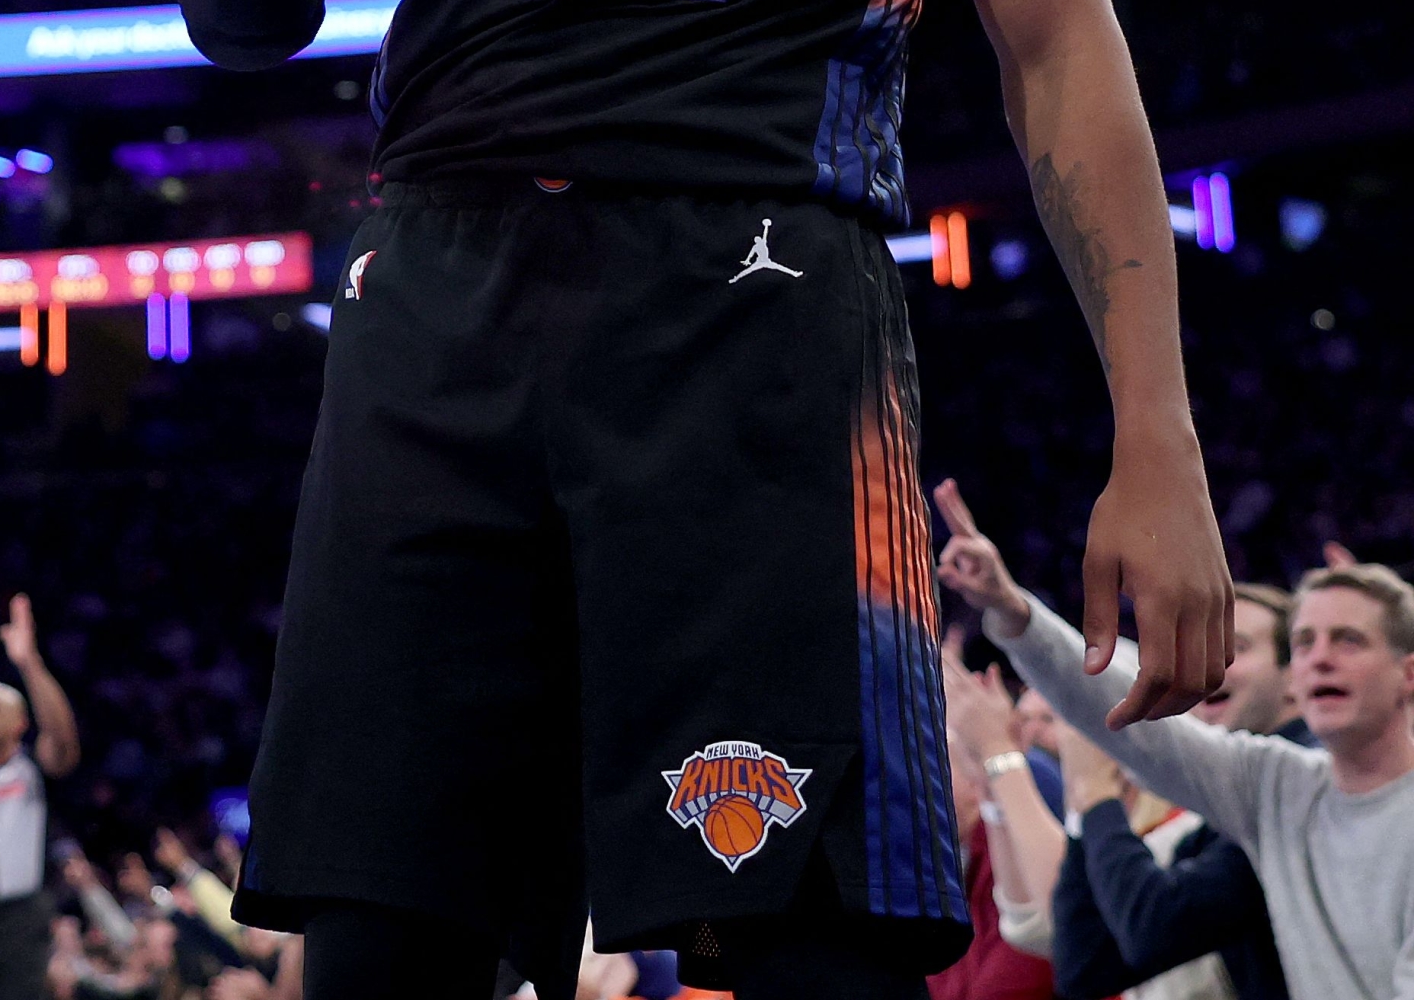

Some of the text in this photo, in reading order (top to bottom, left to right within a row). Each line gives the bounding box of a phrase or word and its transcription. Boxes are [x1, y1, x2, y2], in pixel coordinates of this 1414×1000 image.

[706, 743, 760, 760] NEW YORK
[671, 758, 802, 811] KNICKS
